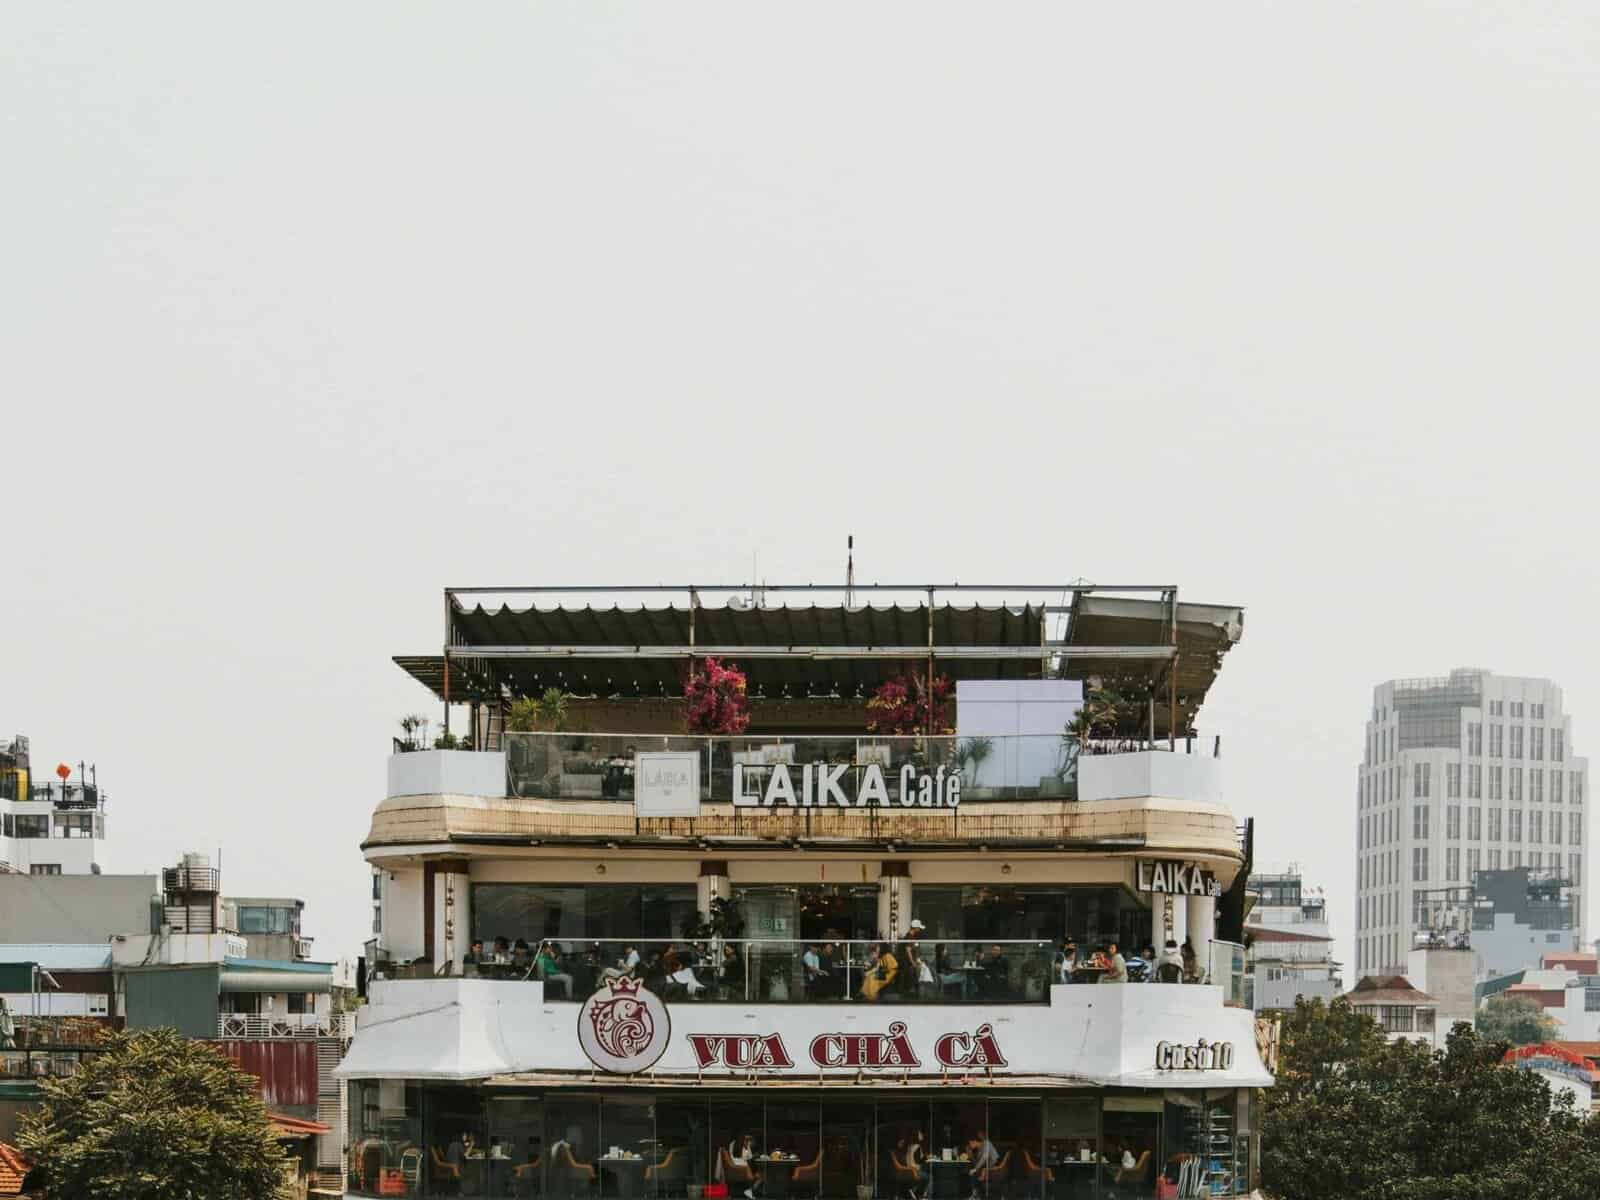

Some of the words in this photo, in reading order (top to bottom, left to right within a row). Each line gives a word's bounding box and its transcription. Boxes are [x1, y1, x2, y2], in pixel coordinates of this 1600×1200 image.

[732, 763, 891, 807] LAIKA
[900, 763, 961, 807] Café
[1137, 860, 1205, 896] LAIKA
[687, 1032, 795, 1069] VUA
[810, 1020, 922, 1068] CHẢ
[934, 1022, 1009, 1069] CÁ
